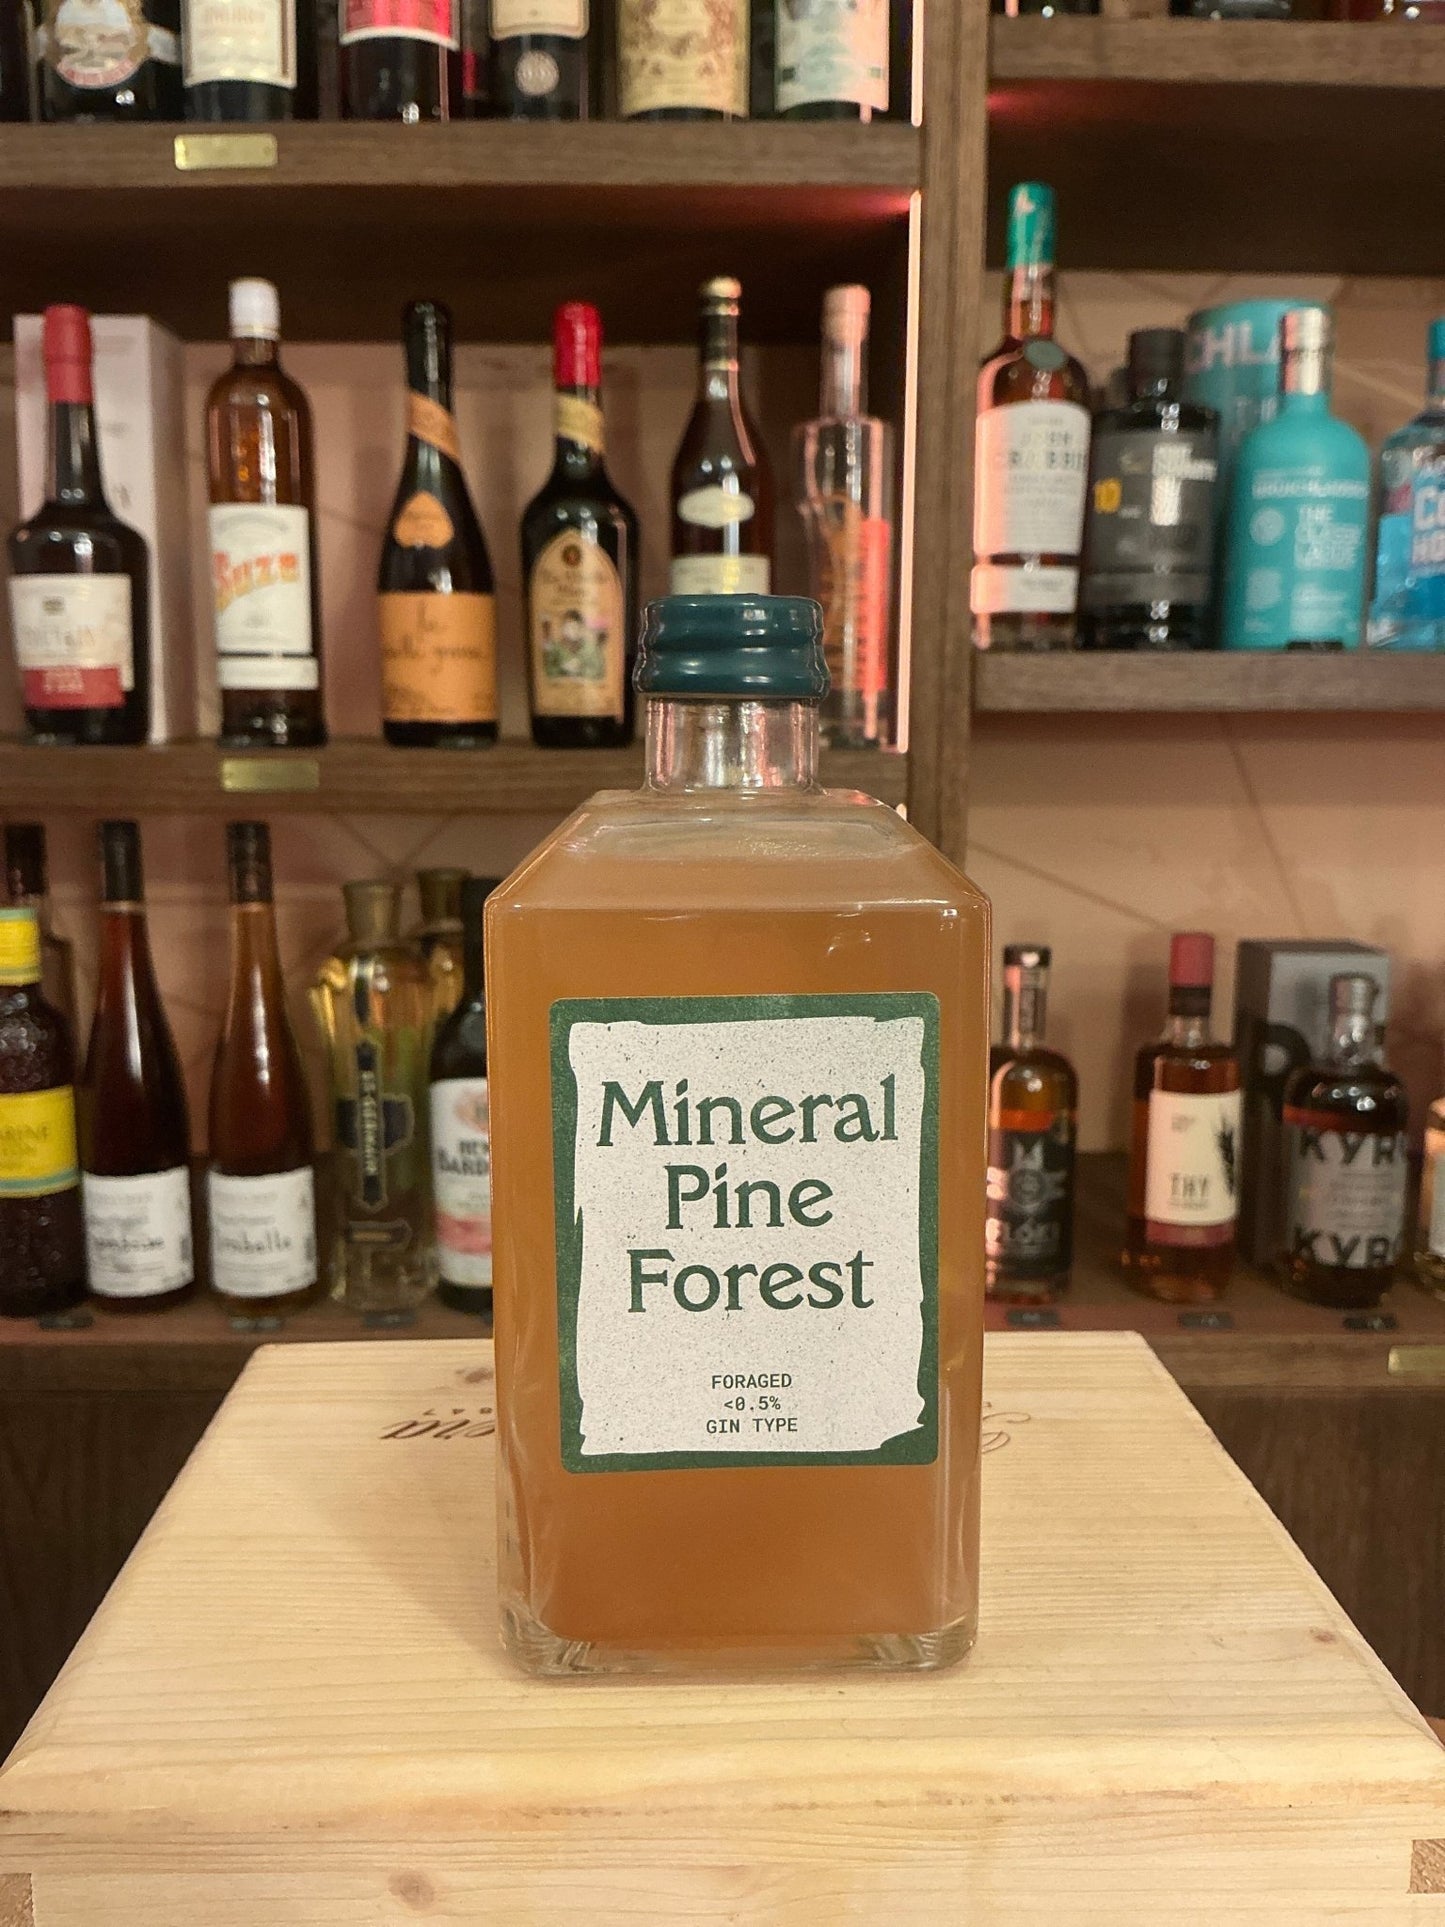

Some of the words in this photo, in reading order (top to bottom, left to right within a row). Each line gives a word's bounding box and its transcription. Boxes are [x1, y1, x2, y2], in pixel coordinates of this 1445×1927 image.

[596, 1073, 899, 1147] Mineral
[665, 1162, 834, 1230] Pine
[627, 1248, 875, 1313] Forest
[711, 1373, 793, 1389] FORAGED
[723, 1395, 781, 1412] <0.5%
[706, 1419, 740, 1434] GIN
[753, 1417, 798, 1433] TYPE
